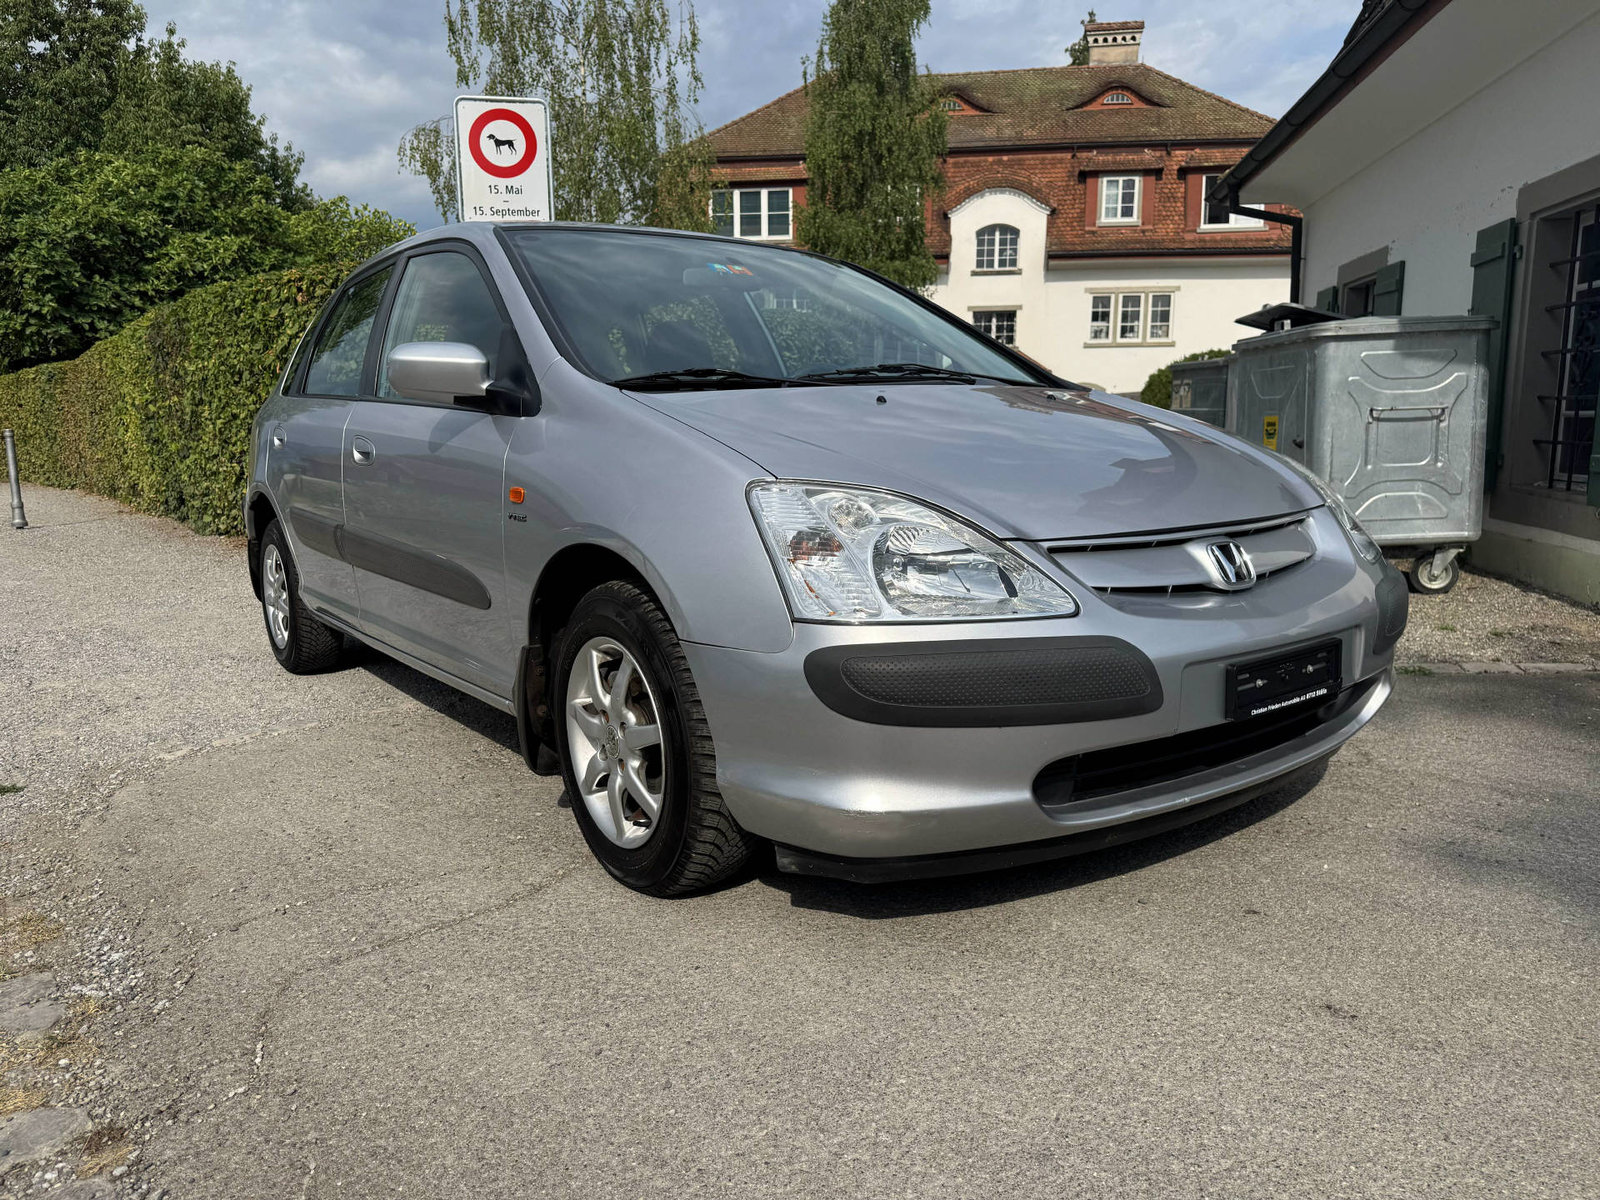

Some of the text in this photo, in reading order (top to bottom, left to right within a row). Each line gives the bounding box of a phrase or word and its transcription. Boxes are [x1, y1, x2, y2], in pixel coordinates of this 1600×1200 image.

[488, 184, 523, 195] 15. Mai
[473, 206, 541, 219] 15. September
